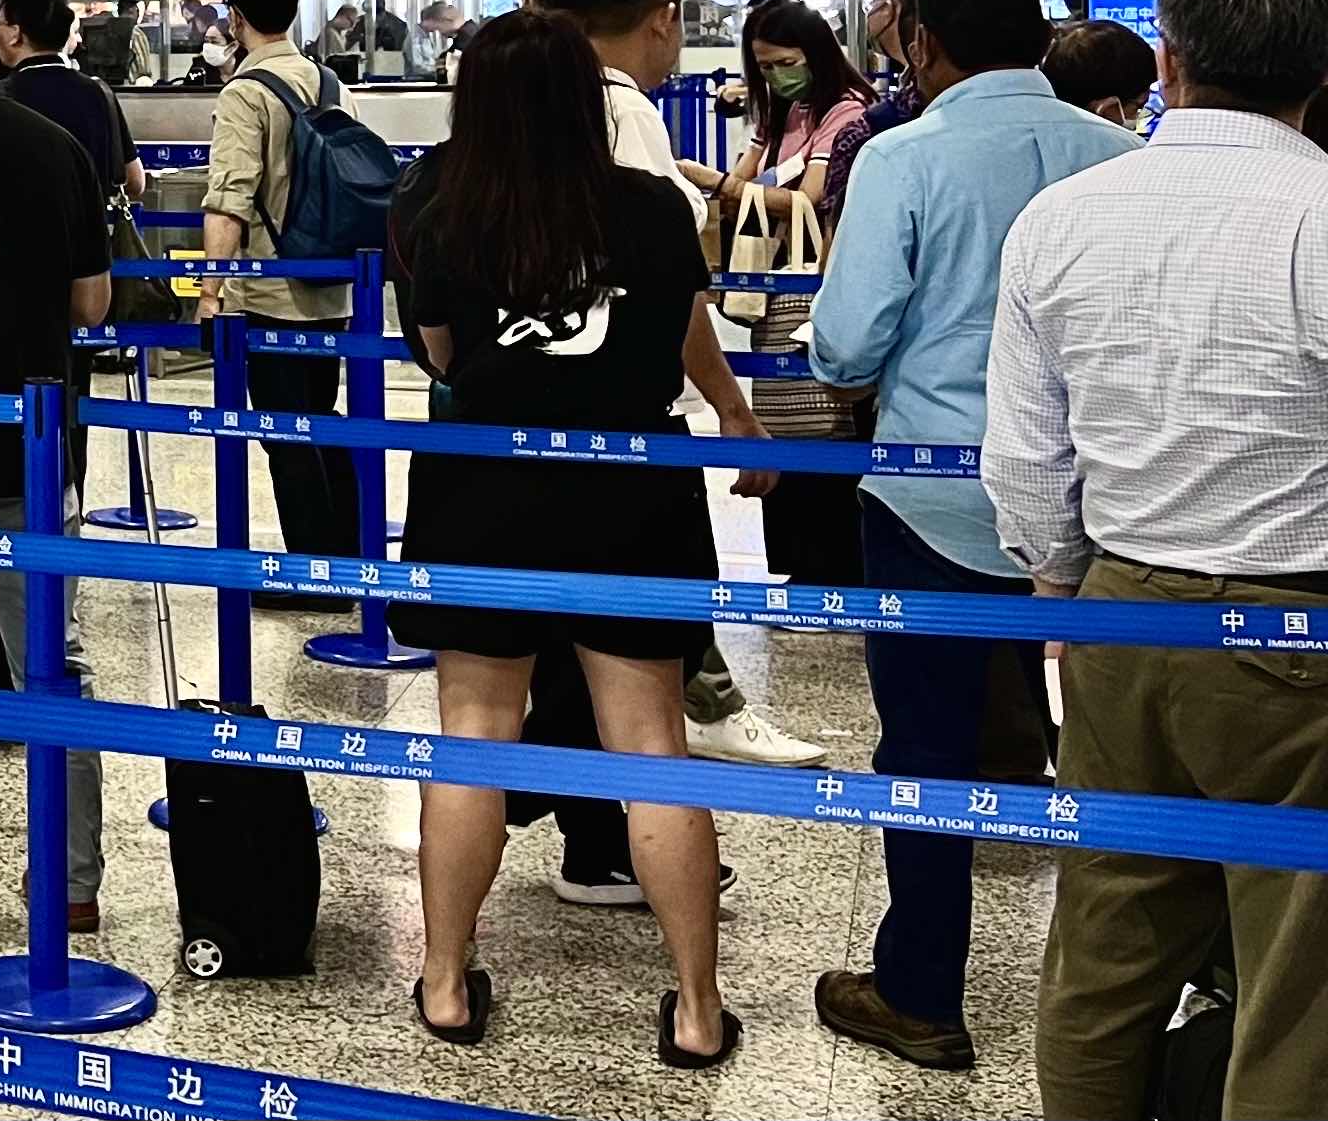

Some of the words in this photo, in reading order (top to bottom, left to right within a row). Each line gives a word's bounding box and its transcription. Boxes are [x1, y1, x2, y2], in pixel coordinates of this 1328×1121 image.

[189, 409, 310, 432] 中国边检
[513, 430, 646, 452] 中国边检
[262, 556, 430, 587] 中国边检
[263, 580, 293, 590] CHINA
[298, 584, 365, 595] IMMIGRATION
[369, 589, 431, 600] INSPECTION
[712, 585, 902, 616] 中国边检
[712, 611, 747, 620] CHINA
[751, 613, 828, 628] IMMIGRATION
[833, 618, 904, 632] INSPECTION
[1222, 610, 1309, 636] 中国
[1223, 636, 1262, 646] CHINA
[214, 720, 434, 762] 中国边检
[212, 749, 251, 760] CHINA
[257, 753, 344, 769] IMMIGRATION
[351, 762, 432, 778] INSPECTION
[816, 775, 1079, 822] 中国边检
[815, 805, 862, 819] CHINA
[869, 811, 974, 830] IMMIGRATION
[982, 822, 1078, 841] INSPECTION
[54, 1091, 178, 1121] IMMIGRATION
